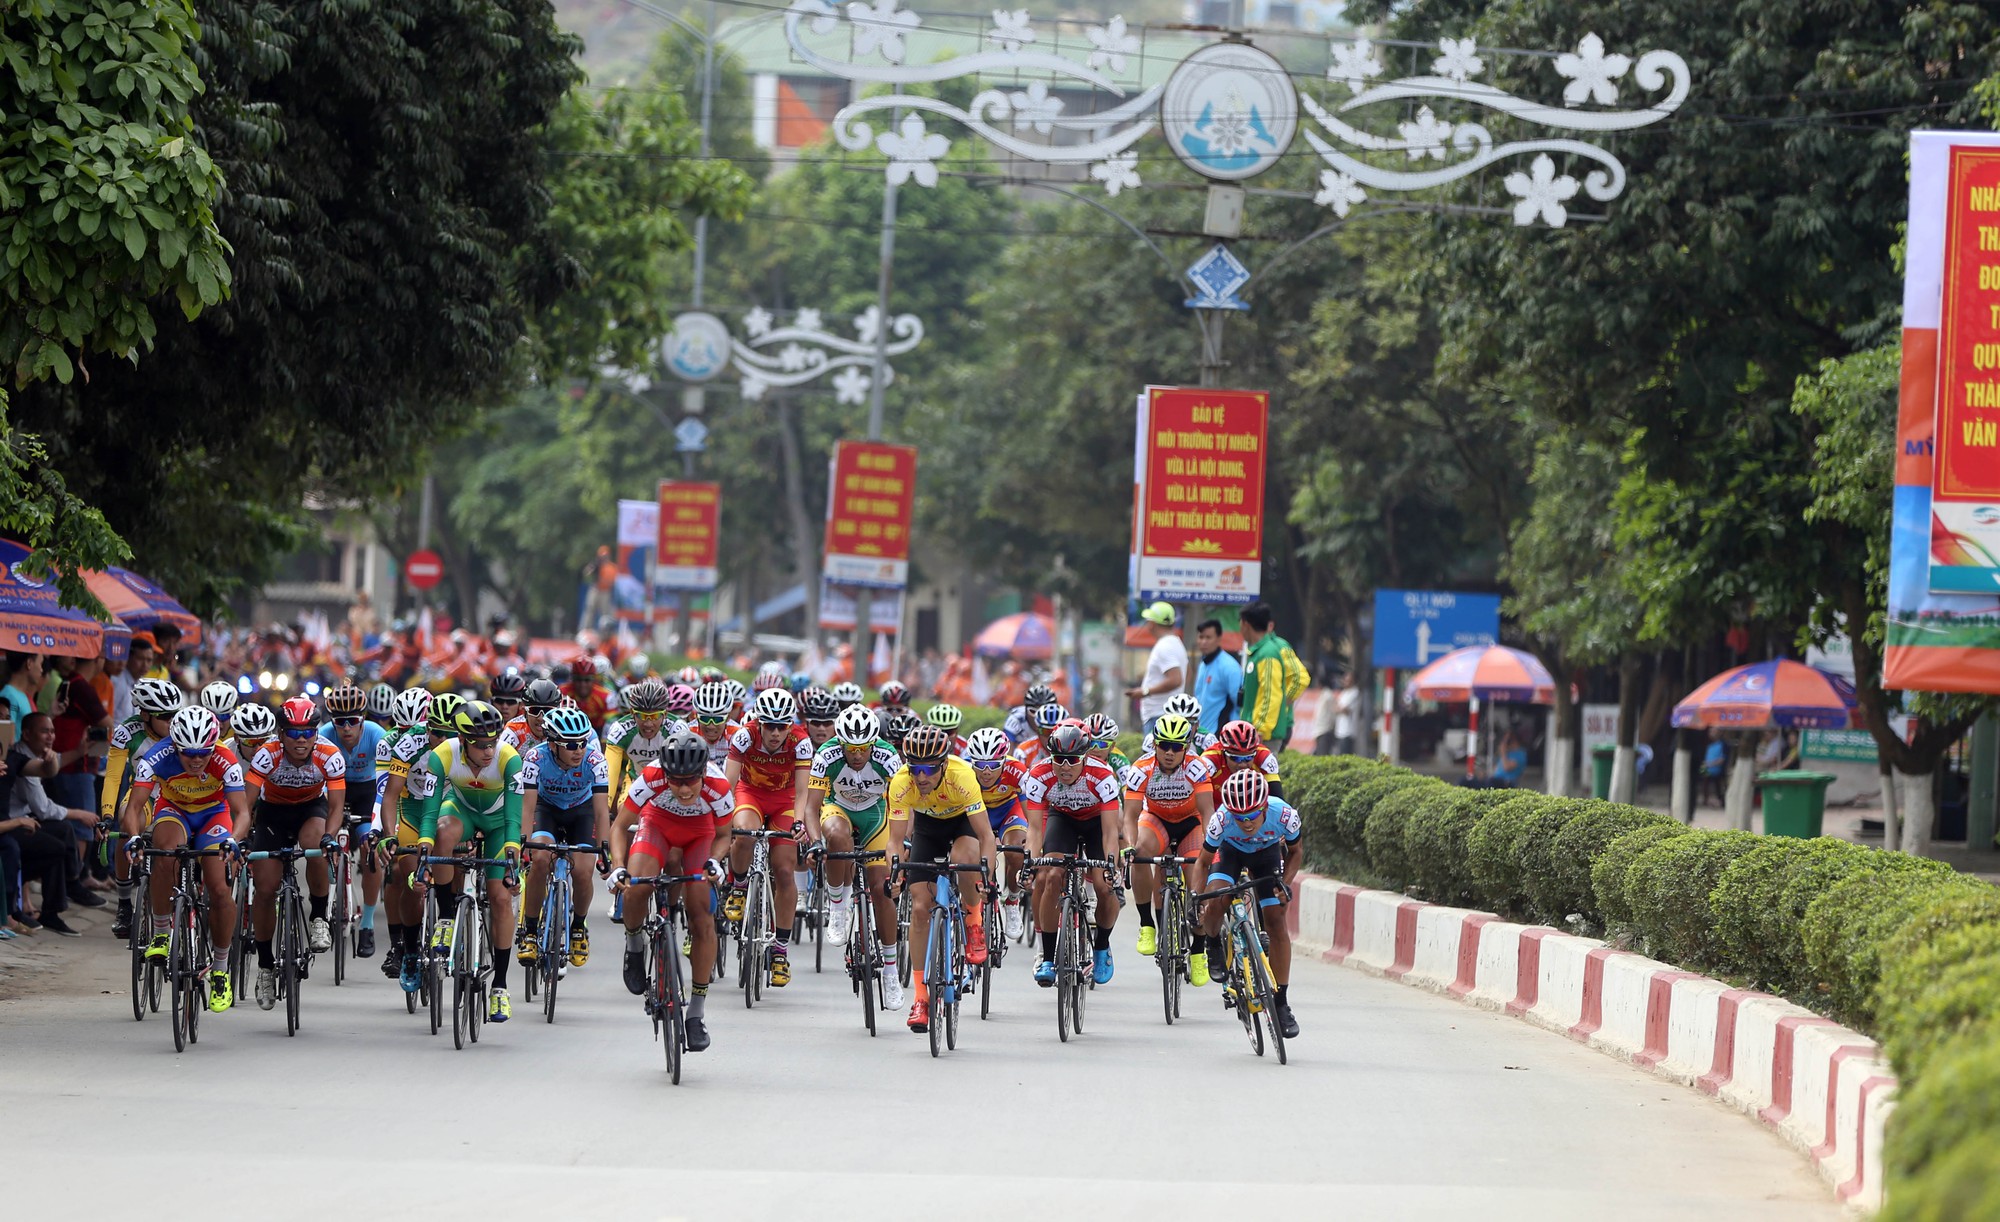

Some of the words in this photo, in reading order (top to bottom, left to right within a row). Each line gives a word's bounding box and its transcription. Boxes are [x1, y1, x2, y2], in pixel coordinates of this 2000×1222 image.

[1963, 416, 1997, 447] VĂN
[397, 738, 415, 758] 124
[256, 753, 271, 770] 12
[331, 757, 343, 774] 12
[229, 769, 242, 783] 61
[522, 765, 535, 780] 45
[1189, 763, 1201, 777] 11
[1129, 772, 1142, 786] 11
[634, 788, 645, 797] 4
[1029, 784, 1039, 797] 2
[1104, 783, 1114, 795] 2
[723, 800, 731, 810] 4
